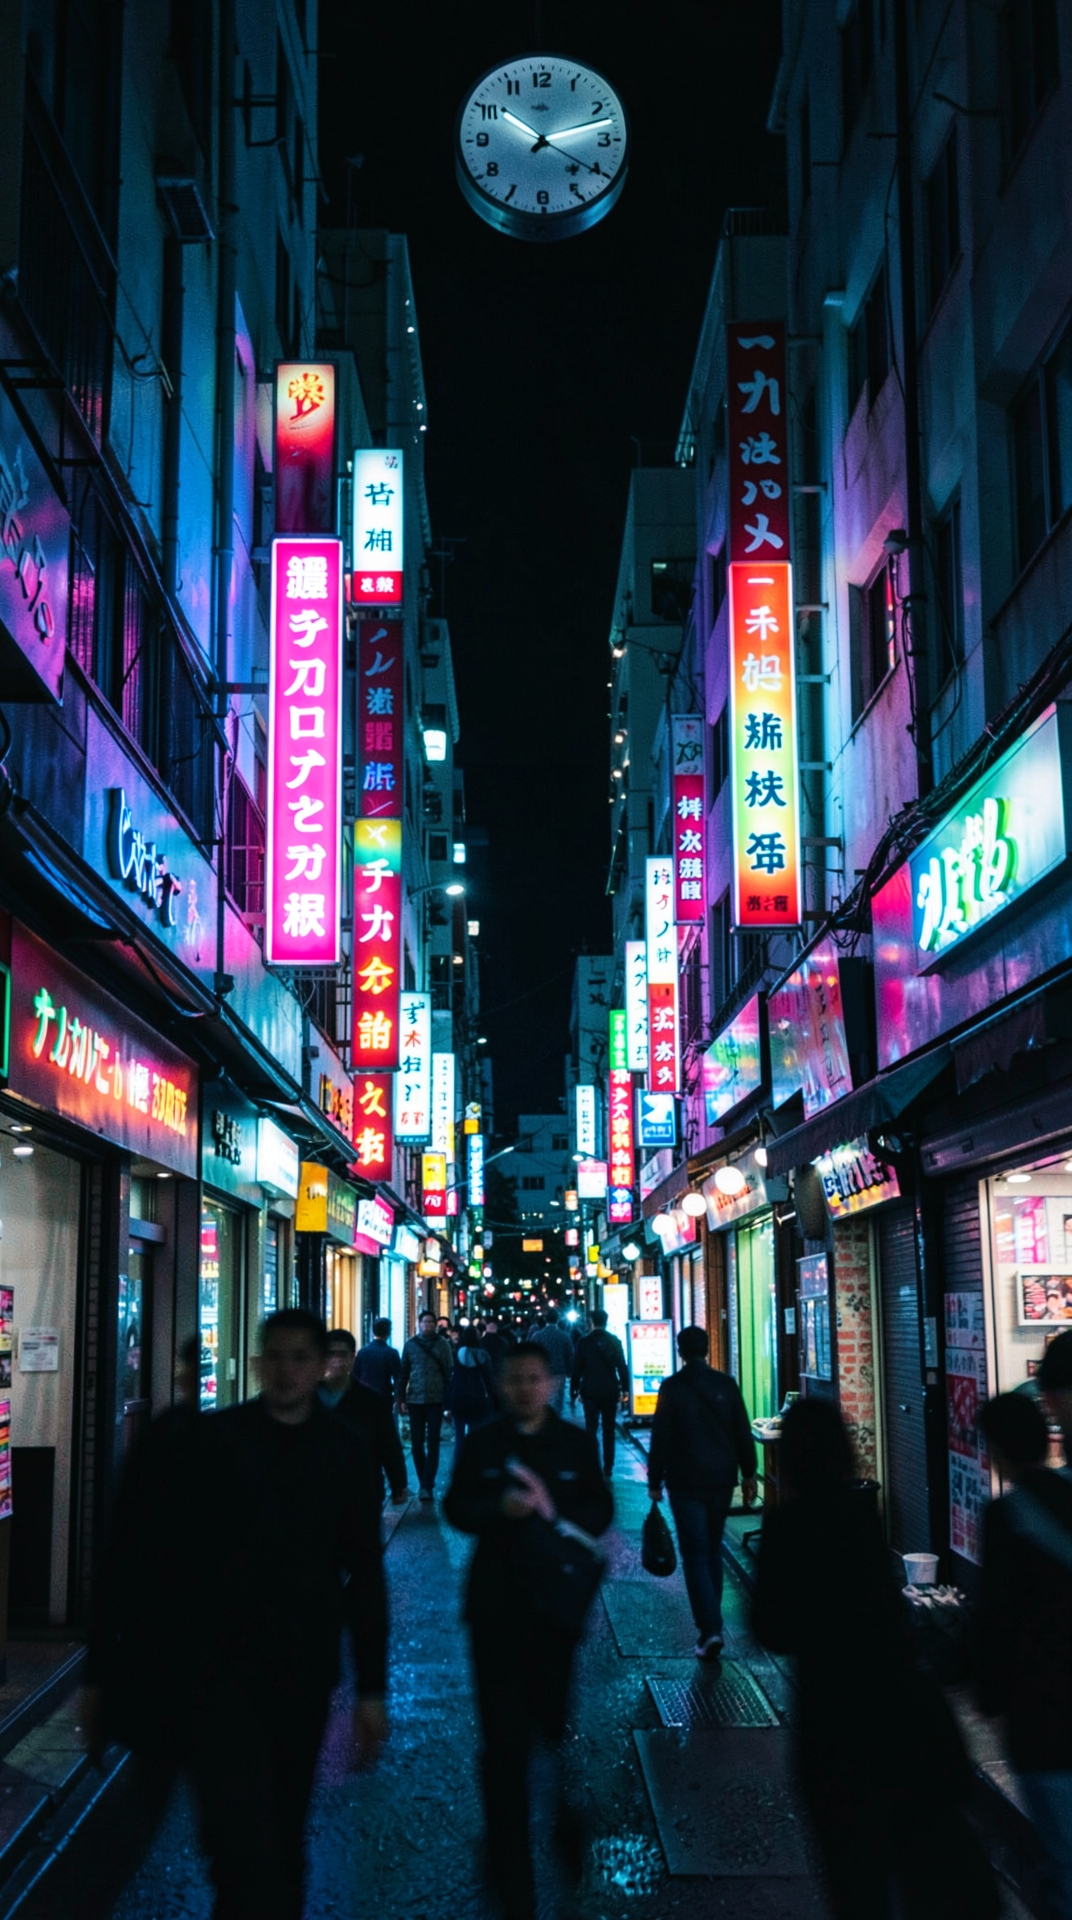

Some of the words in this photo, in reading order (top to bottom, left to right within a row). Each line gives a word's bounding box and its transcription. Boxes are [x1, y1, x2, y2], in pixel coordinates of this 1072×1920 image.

[507, 79, 520, 96] 11
[533, 72, 552, 88] 12
[591, 101, 604, 116] 2
[476, 132, 489, 147] 9
[597, 132, 611, 147] 3
[486, 161, 499, 177] 8
